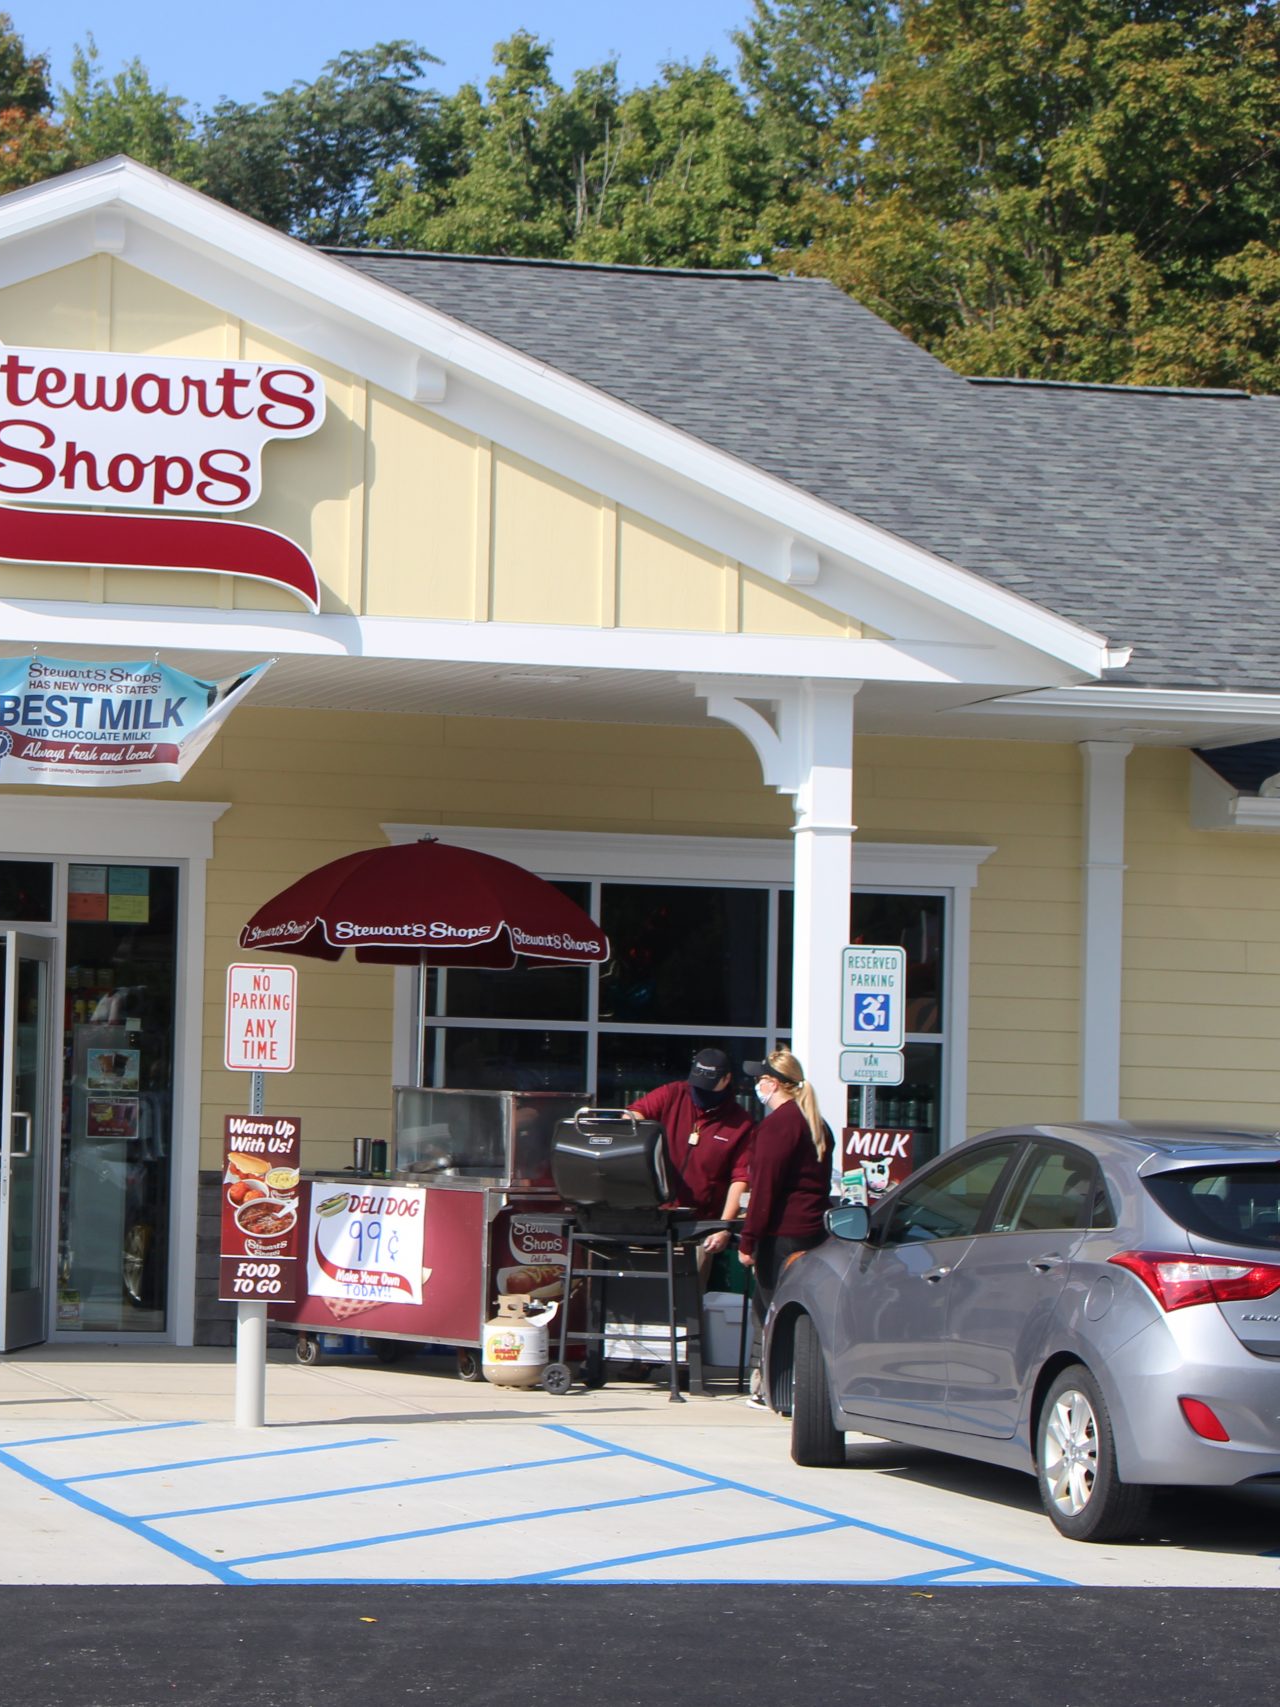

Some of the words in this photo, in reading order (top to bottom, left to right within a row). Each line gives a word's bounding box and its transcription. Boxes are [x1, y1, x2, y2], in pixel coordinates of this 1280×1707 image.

[109, 668, 162, 683] Shops
[29, 681, 51, 690] HAS
[53, 682, 79, 691] NEW
[82, 683, 113, 693] YORK
[99, 697, 187, 730] MILK
[26, 728, 49, 738] AND
[52, 729, 120, 741] CHOCOLATE
[21, 741, 65, 762] Always
[68, 744, 98, 761] fresh
[99, 746, 126, 762] and
[126, 744, 157, 760] local
[429, 921, 491, 939] Shops
[848, 956, 898, 970] RESERVED
[253, 975, 271, 992] NO
[851, 973, 895, 988] PARKING
[232, 993, 290, 1011] PARKING
[244, 1018, 277, 1038] ANY
[242, 1040, 278, 1060] TIME
[863, 1056, 879, 1067] VAN
[854, 1070, 889, 1078] ACCESSIBLE
[229, 1118, 274, 1135] Warm
[275, 1120, 296, 1139] Up
[231, 1136, 266, 1153] With
[268, 1138, 294, 1153] Us!
[846, 1131, 910, 1159] MILK
[348, 1194, 384, 1215] DELI
[385, 1197, 420, 1217] DOG
[522, 1235, 563, 1252] Shops
[236, 1262, 281, 1278] FOOD
[335, 1269, 360, 1283] Make
[360, 1270, 380, 1285] Your
[381, 1272, 401, 1287] Own
[233, 1278, 254, 1293] TO
[256, 1278, 282, 1294] GO
